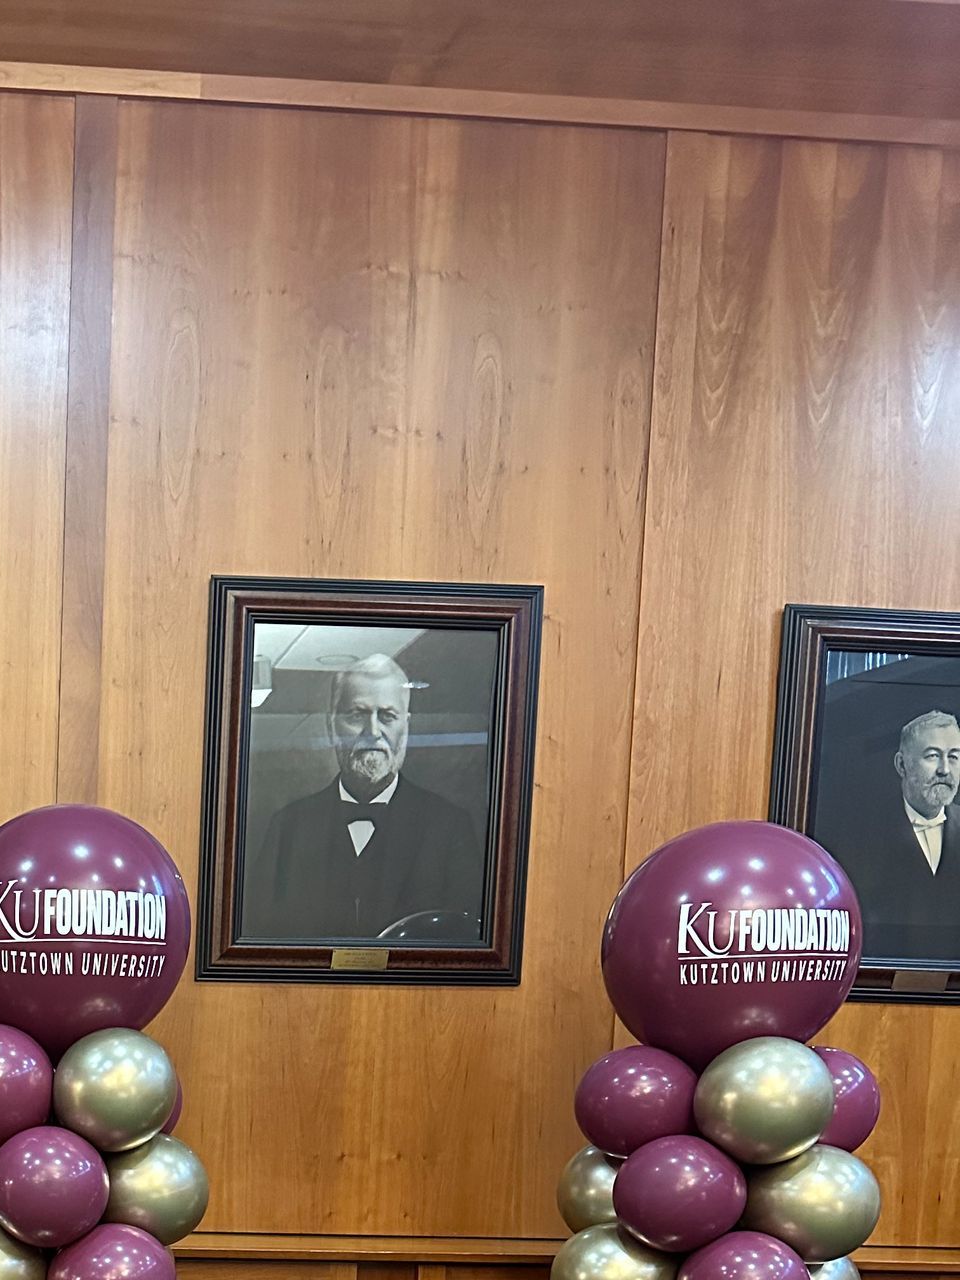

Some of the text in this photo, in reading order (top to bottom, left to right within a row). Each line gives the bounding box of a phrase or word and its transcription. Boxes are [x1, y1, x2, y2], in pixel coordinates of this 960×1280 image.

[81, 952, 166, 978] UNIVERSITY
[680, 960, 847, 985] KUTZTOWN UNIVERSITY
